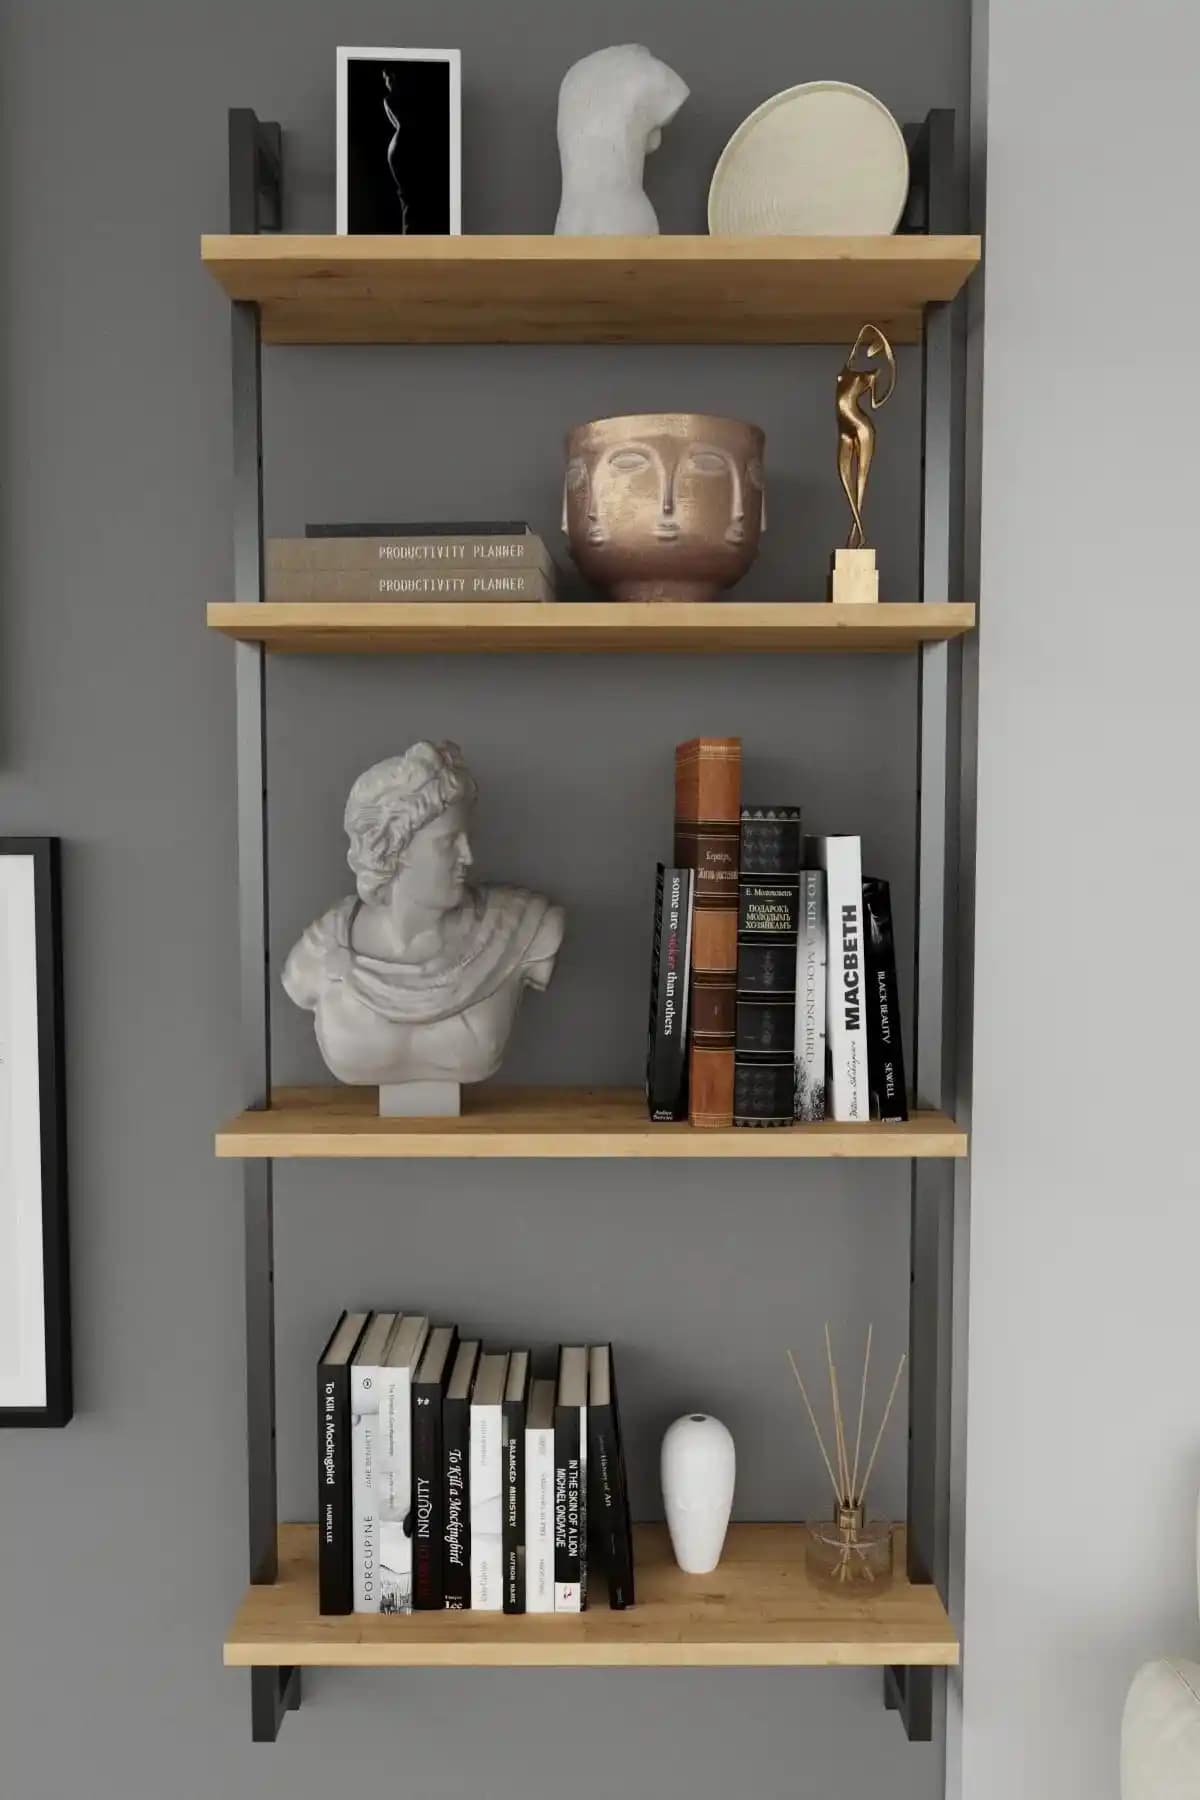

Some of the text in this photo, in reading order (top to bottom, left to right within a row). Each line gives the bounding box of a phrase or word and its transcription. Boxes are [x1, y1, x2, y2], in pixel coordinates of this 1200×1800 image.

[379, 544, 525, 559] PRODUCTIVITY PLANNER
[379, 578, 525, 592] PRODUCTIVITY PLANNER
[671, 877, 681, 908] some
[807, 873, 817, 897] TO
[670, 911, 679, 930] are
[807, 900, 817, 929] KILL
[842, 905, 860, 1030] MACBETH
[666, 971, 677, 996] than
[663, 999, 675, 1036] others
[805, 951, 817, 1064] MOCKINGBIRD
[877, 971, 895, 1099] BLACK BEAUTY SEWELL
[325, 1382, 335, 1395] To
[325, 1396, 335, 1412] Kill
[324, 1423, 335, 1484] Mockingbird
[568, 1459, 577, 1469] IN
[509, 1438, 517, 1527] BALANCED MINISTRY
[568, 1470, 577, 1489] THE
[417, 1477, 432, 1538] INIQUITY
[444, 1448, 463, 1567] To Kill a Mockingbird
[556, 1468, 566, 1548] MICHAEL ONDAATJE
[568, 1490, 577, 1512] SKIN
[603, 1493, 612, 1508] Art
[568, 1513, 577, 1525] OF
[363, 1515, 373, 1601] PORCUPINE
[568, 1535, 577, 1557] LION
